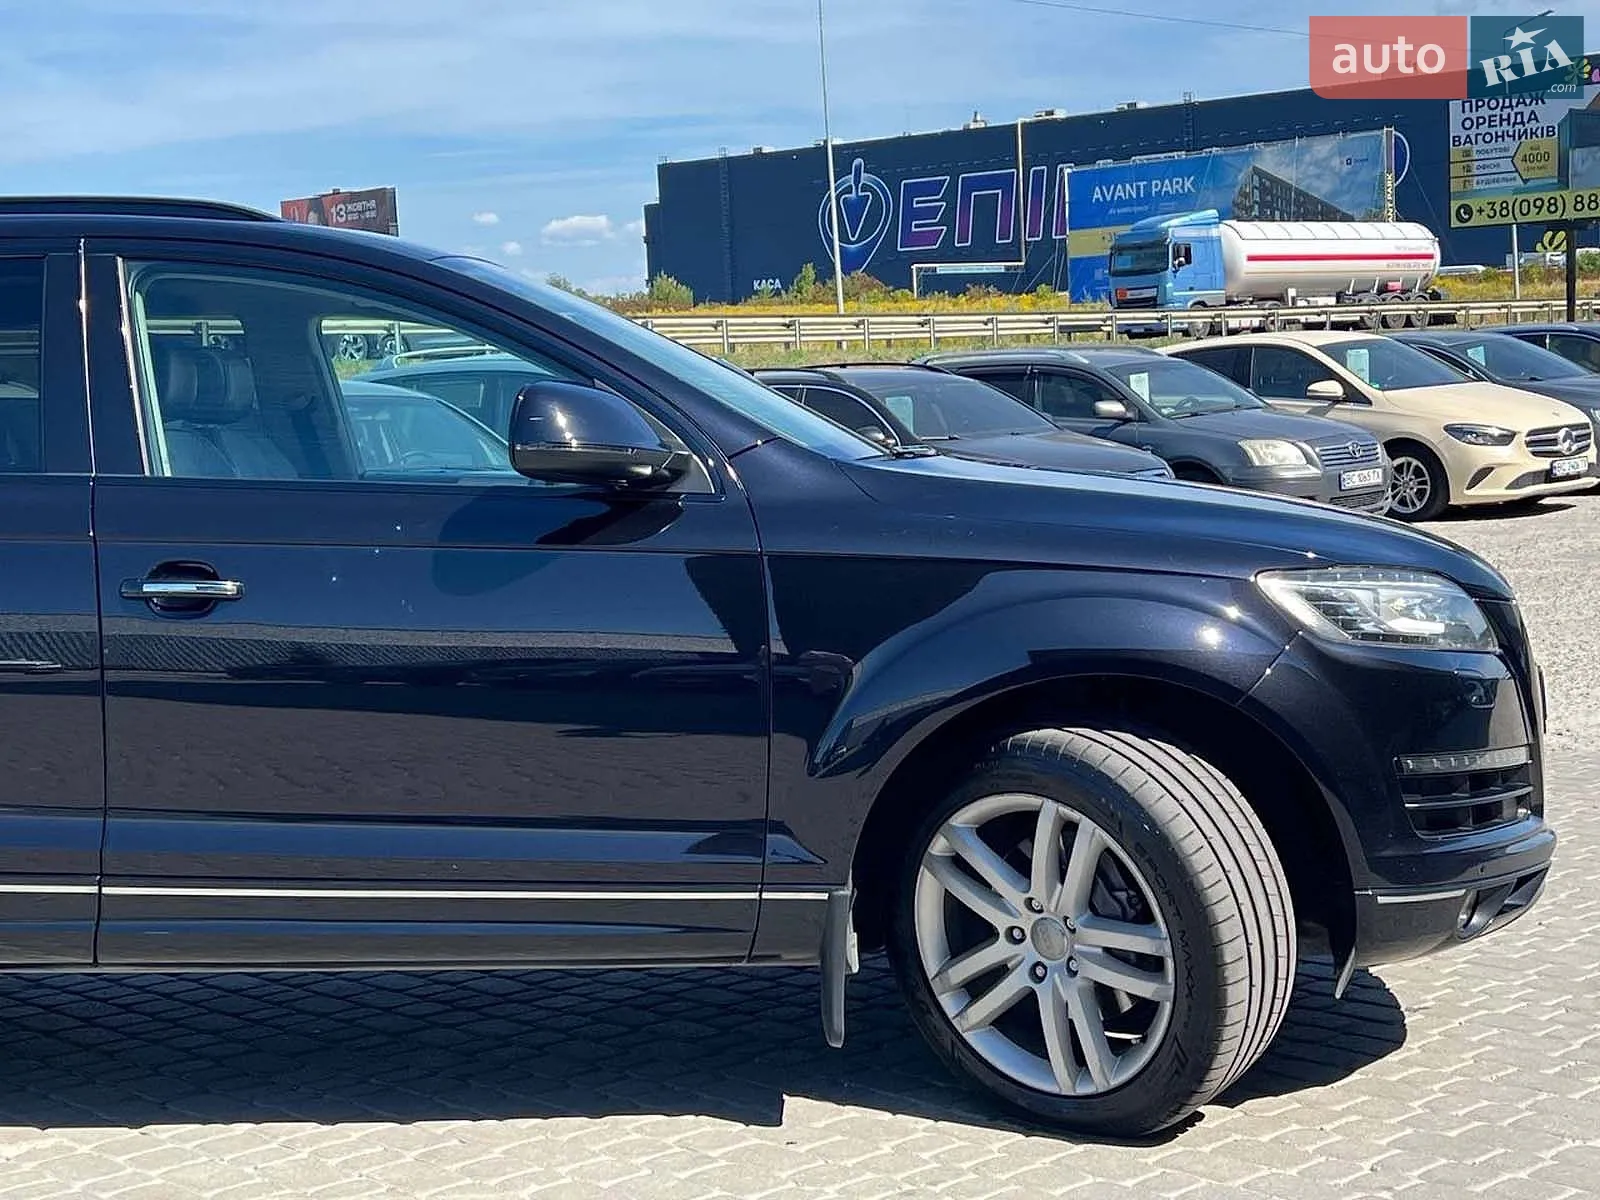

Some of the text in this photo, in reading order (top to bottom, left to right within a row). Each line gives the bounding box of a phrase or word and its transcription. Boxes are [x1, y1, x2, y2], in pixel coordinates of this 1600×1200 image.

[1461, 90, 1546, 114] ПРОДАЖ
[1461, 109, 1540, 132] ОРЕНДА
[1452, 125, 1556, 147] ВАГОНЧИКІВ
[1520, 151, 1550, 164] 4000
[1092, 176, 1196, 203] AVANT PARK
[331, 204, 347, 225] 13
[1476, 194, 1566, 221] +38(098)
